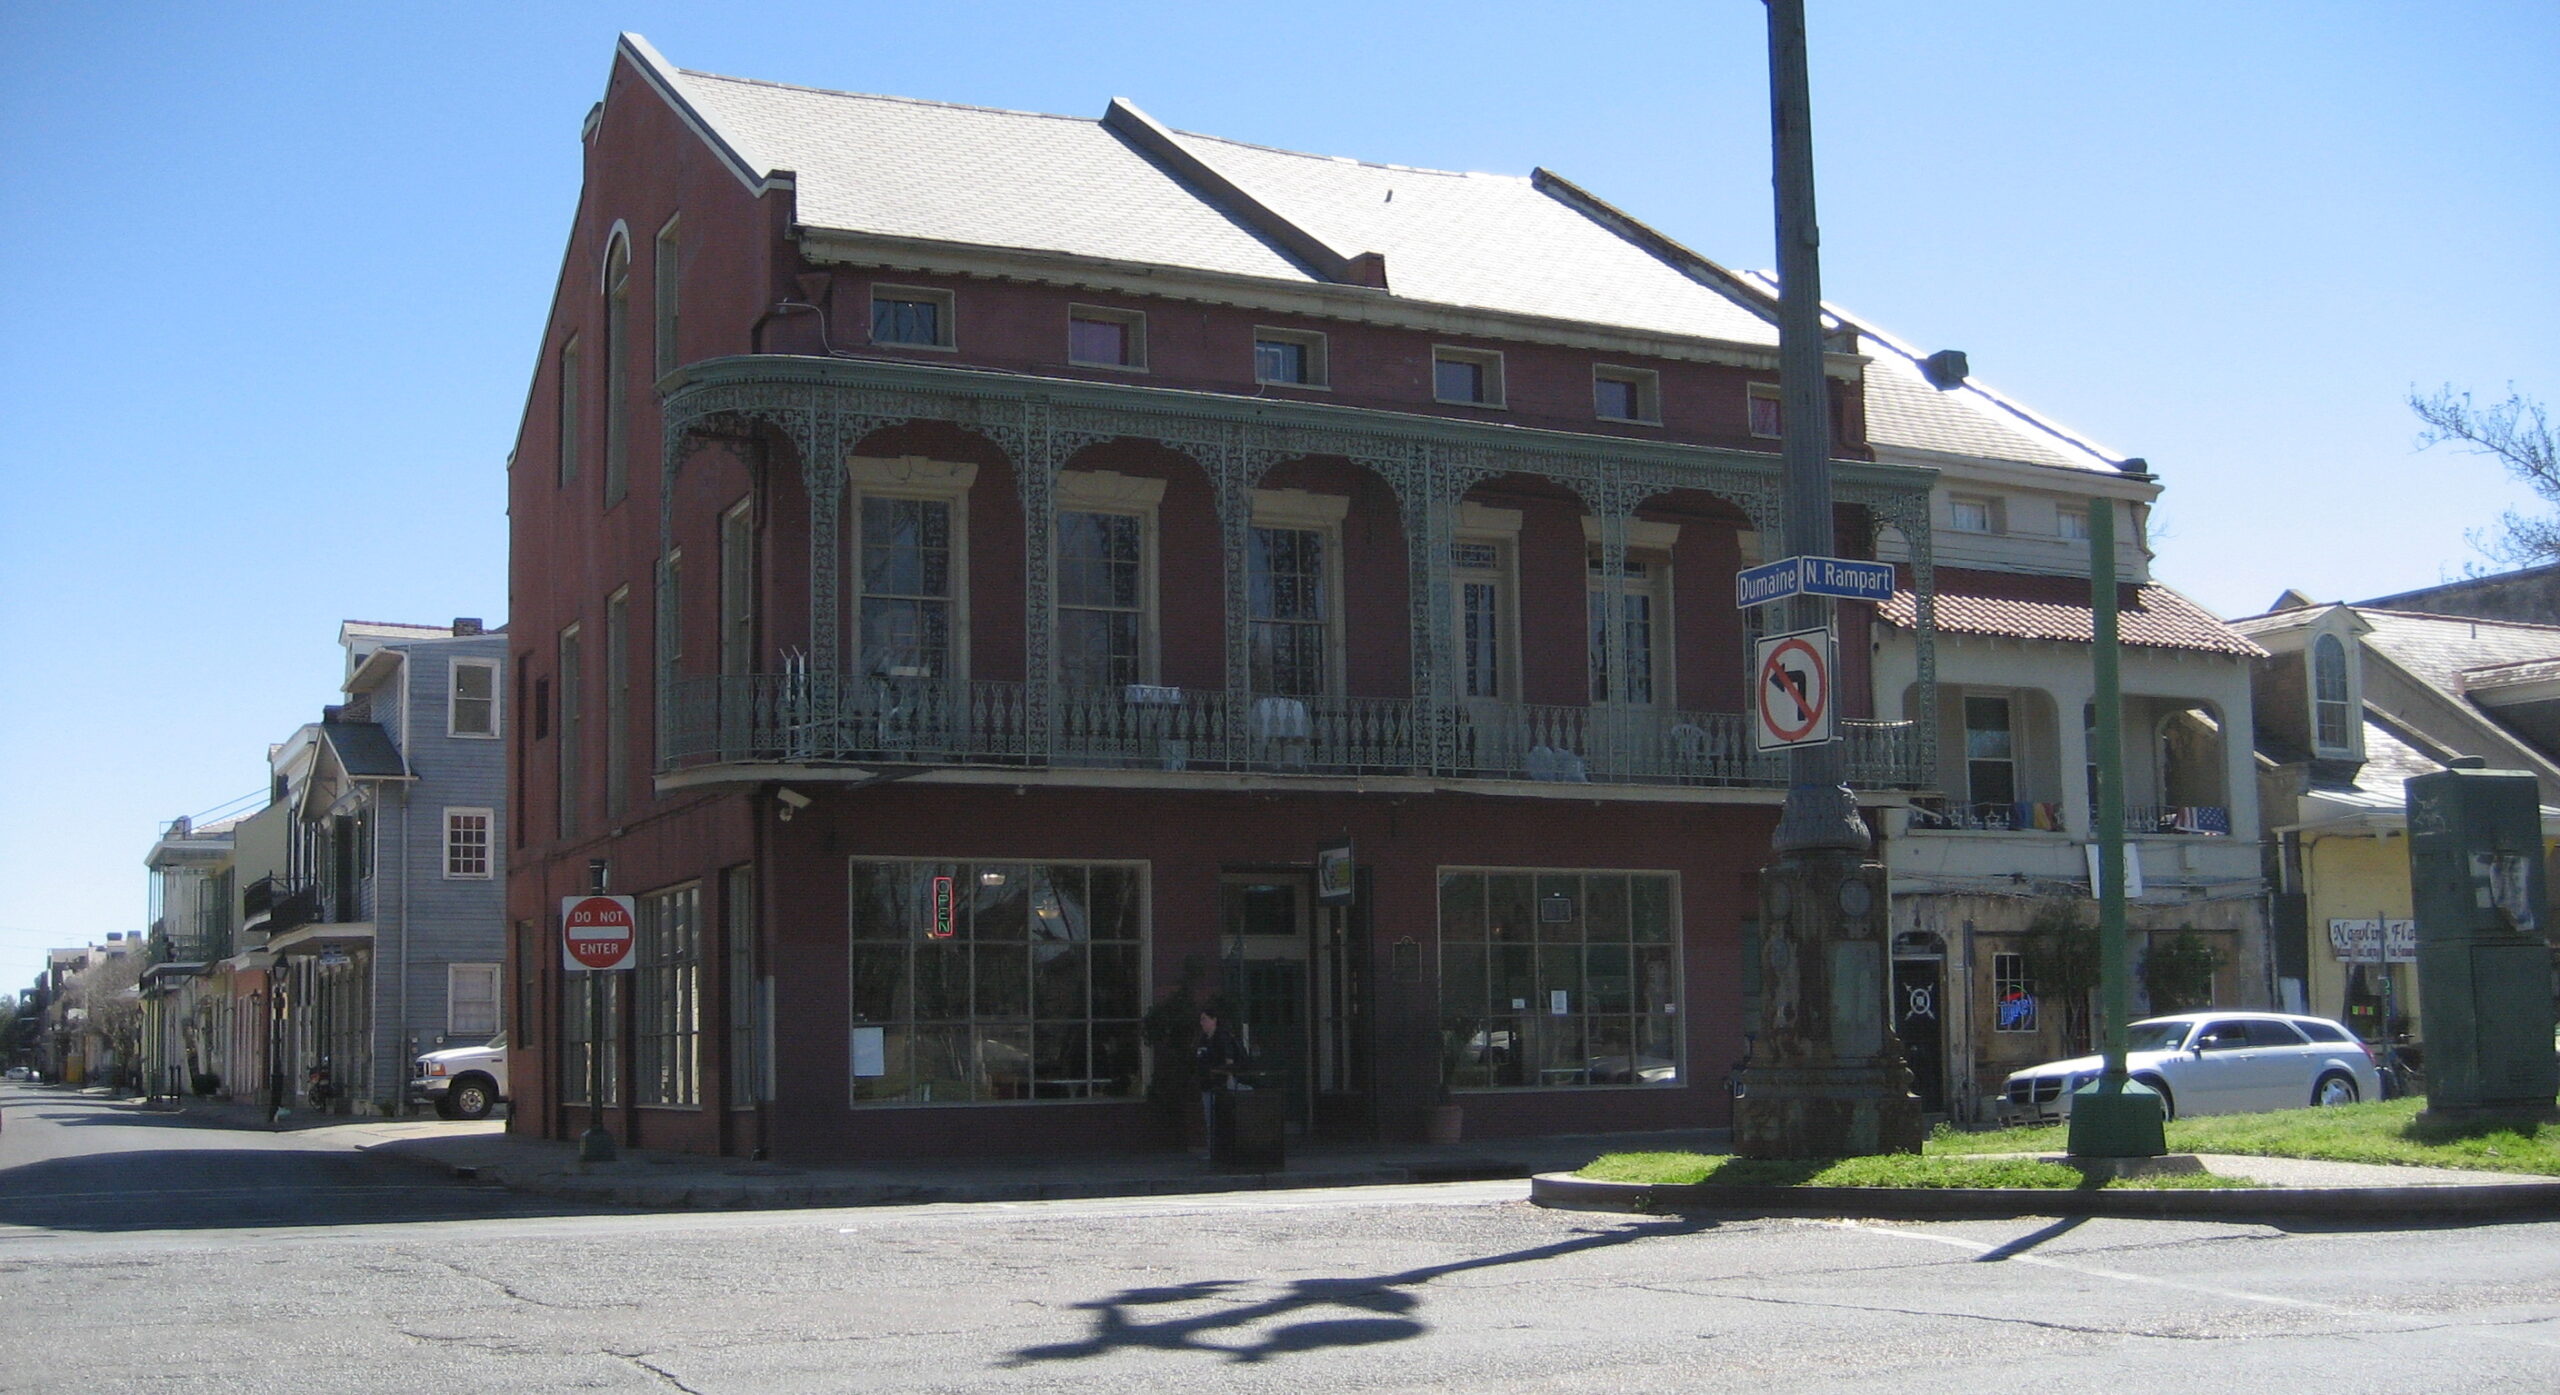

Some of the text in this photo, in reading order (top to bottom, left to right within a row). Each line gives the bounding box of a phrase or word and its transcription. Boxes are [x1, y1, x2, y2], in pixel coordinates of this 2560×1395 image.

[1739, 567, 1796, 602] Dumaine
[1805, 560, 1890, 594] N. Rampart
[574, 910, 624, 923] DO NOT
[937, 880, 950, 933] OPEN
[579, 943, 619, 954] ENTER
